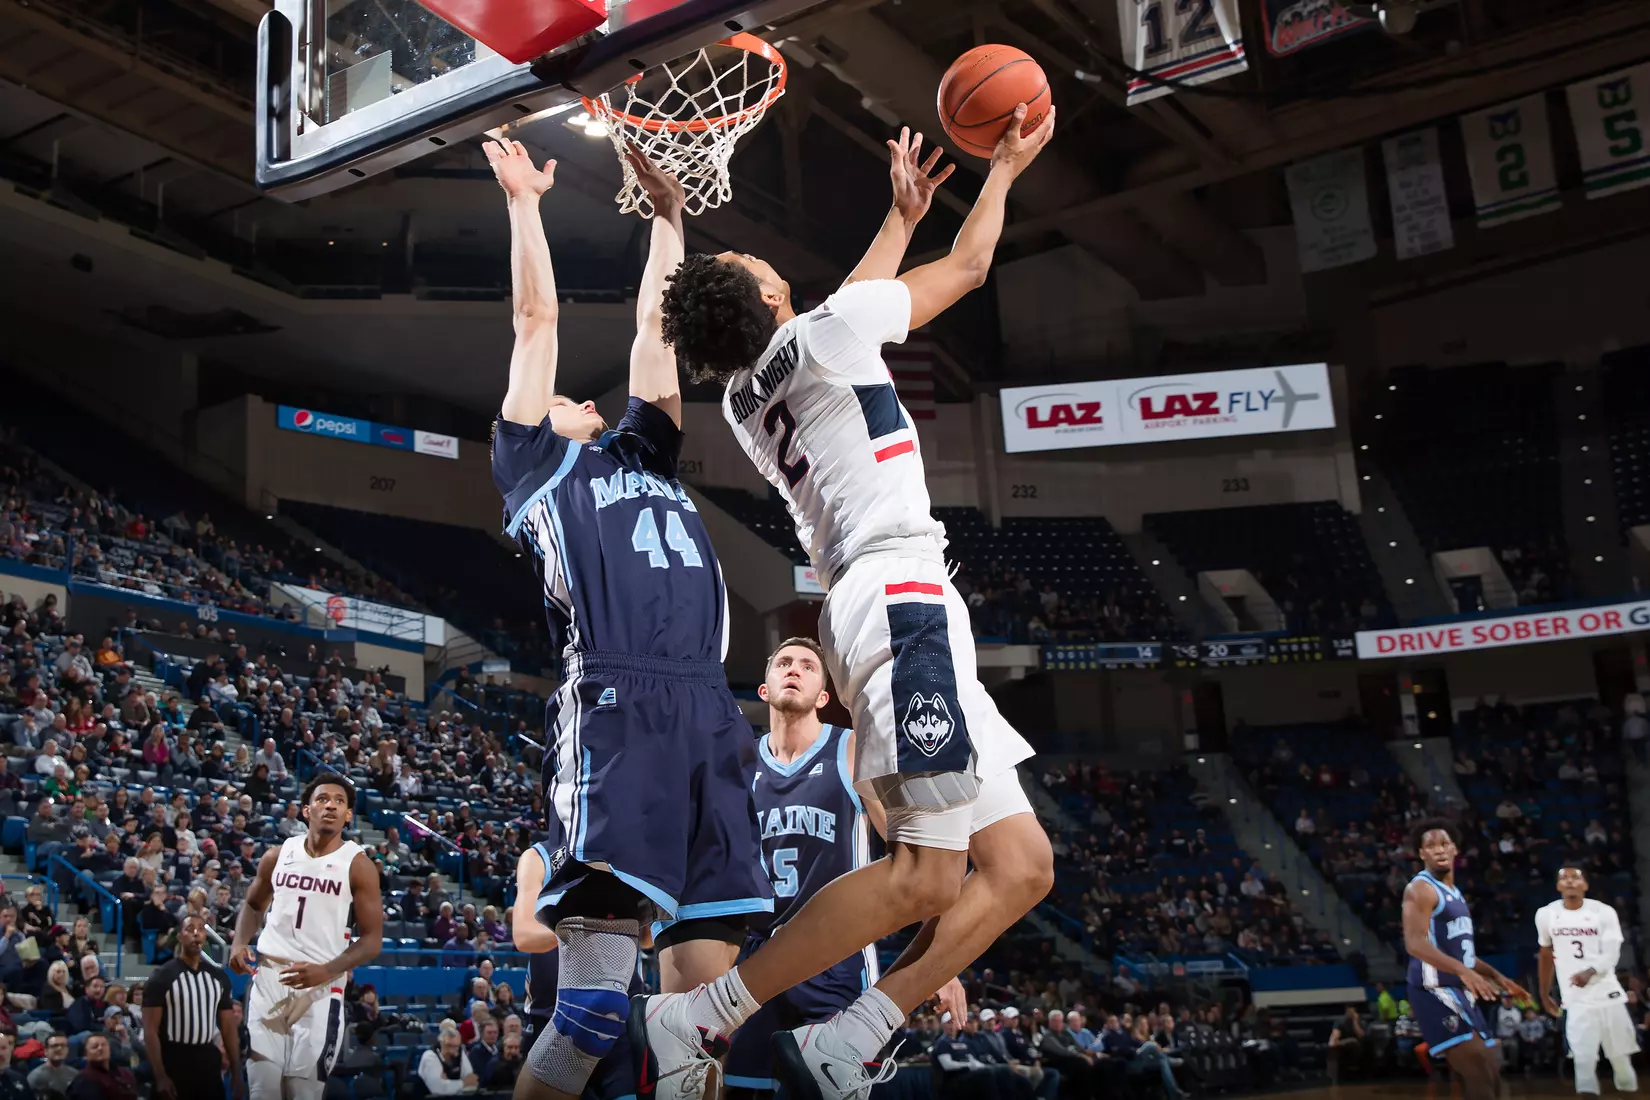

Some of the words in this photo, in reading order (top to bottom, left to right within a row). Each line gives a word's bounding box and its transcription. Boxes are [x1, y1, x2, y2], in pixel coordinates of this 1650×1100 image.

[1142, 0, 1221, 59] 12
[1026, 402, 1103, 429] LAZ
[1139, 391, 1220, 420] LAZ
[1228, 389, 1276, 414] FLY
[316, 418, 357, 435] pepsi
[763, 400, 811, 489] 2
[369, 476, 396, 491] 207
[1011, 484, 1038, 499] 232
[1222, 478, 1250, 493] 233
[631, 507, 703, 569] 44
[197, 606, 218, 622] 105
[1375, 628, 1465, 654] DRIVE
[1471, 615, 1572, 645] SOBER
[1578, 609, 1623, 632] OR
[1629, 606, 1650, 625] G
[1208, 644, 1229, 658] 20
[275, 872, 342, 896] UCONN
[295, 895, 307, 930] 1
[1552, 927, 1599, 937] UCONN
[1571, 940, 1585, 960] 3
